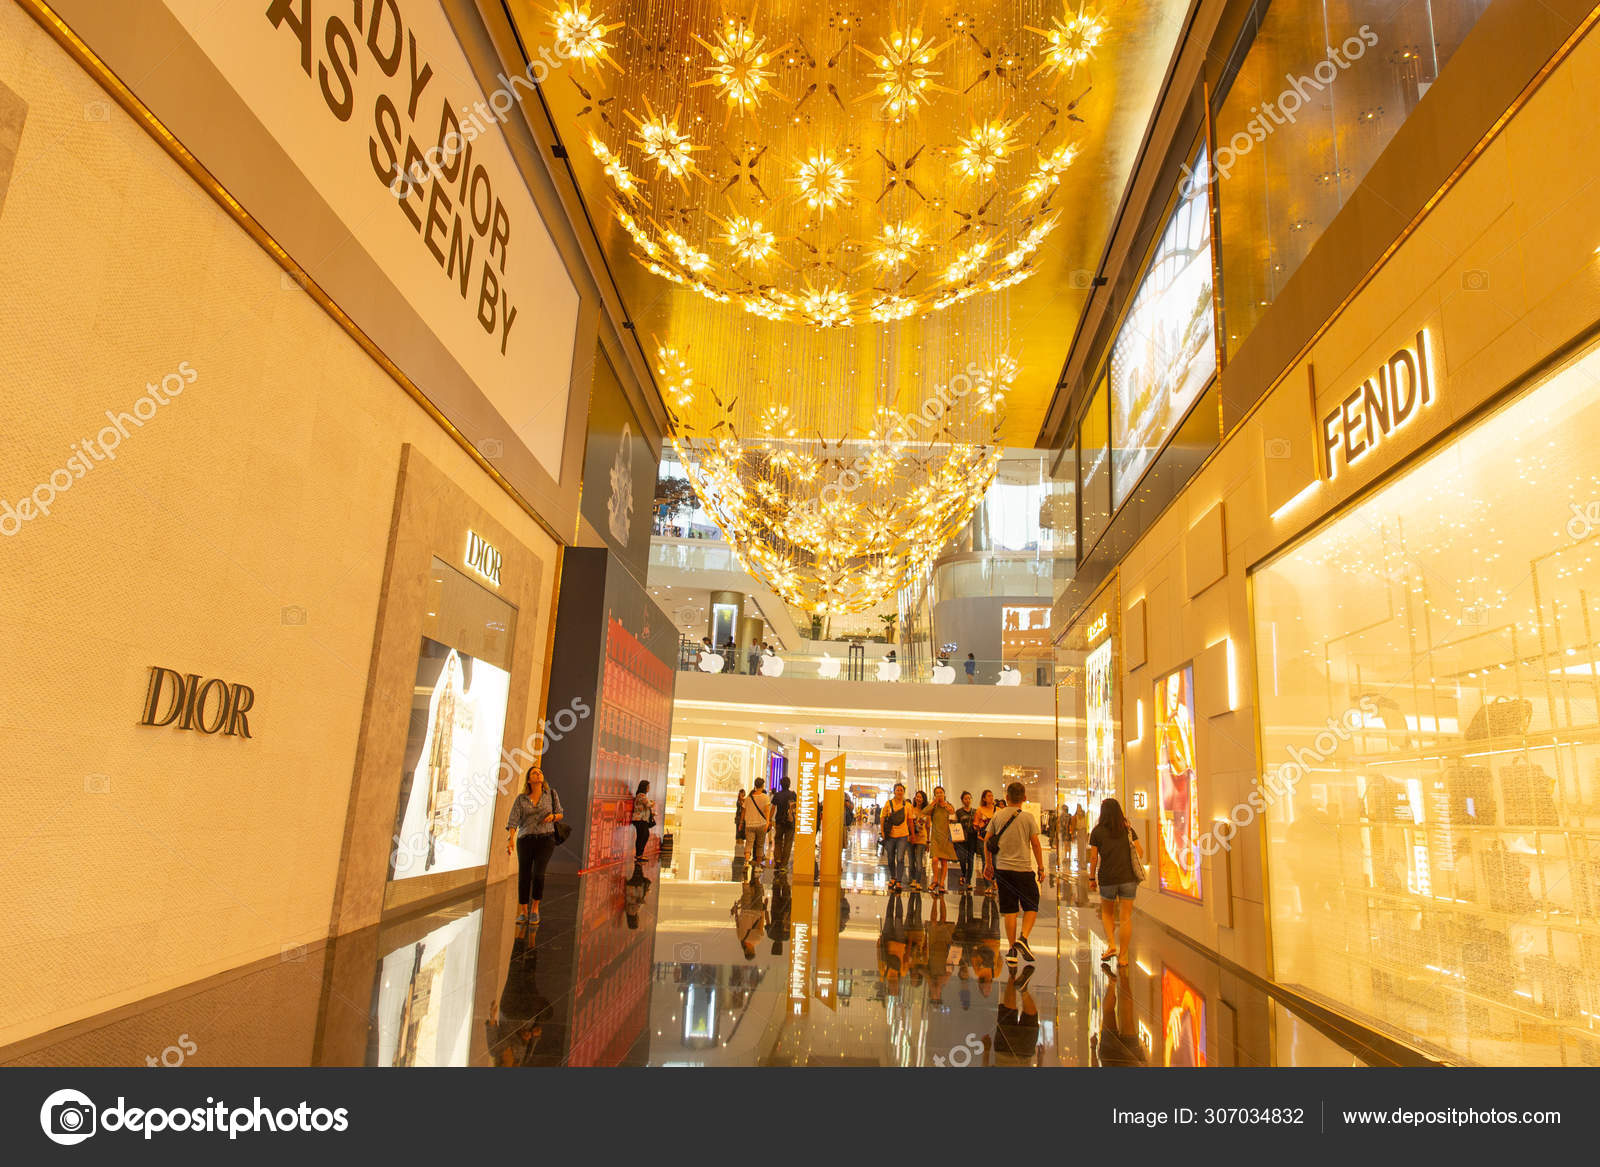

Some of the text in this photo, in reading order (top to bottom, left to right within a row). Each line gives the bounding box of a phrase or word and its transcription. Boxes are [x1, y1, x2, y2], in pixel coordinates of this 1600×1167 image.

[353, 0, 510, 275] DY DIOR
[369, 94, 474, 300] SEEN
[477, 260, 517, 356] BY
[1323, 328, 1436, 480] FENDI
[465, 530, 502, 586] DIOR
[136, 666, 255, 739] DIOR
